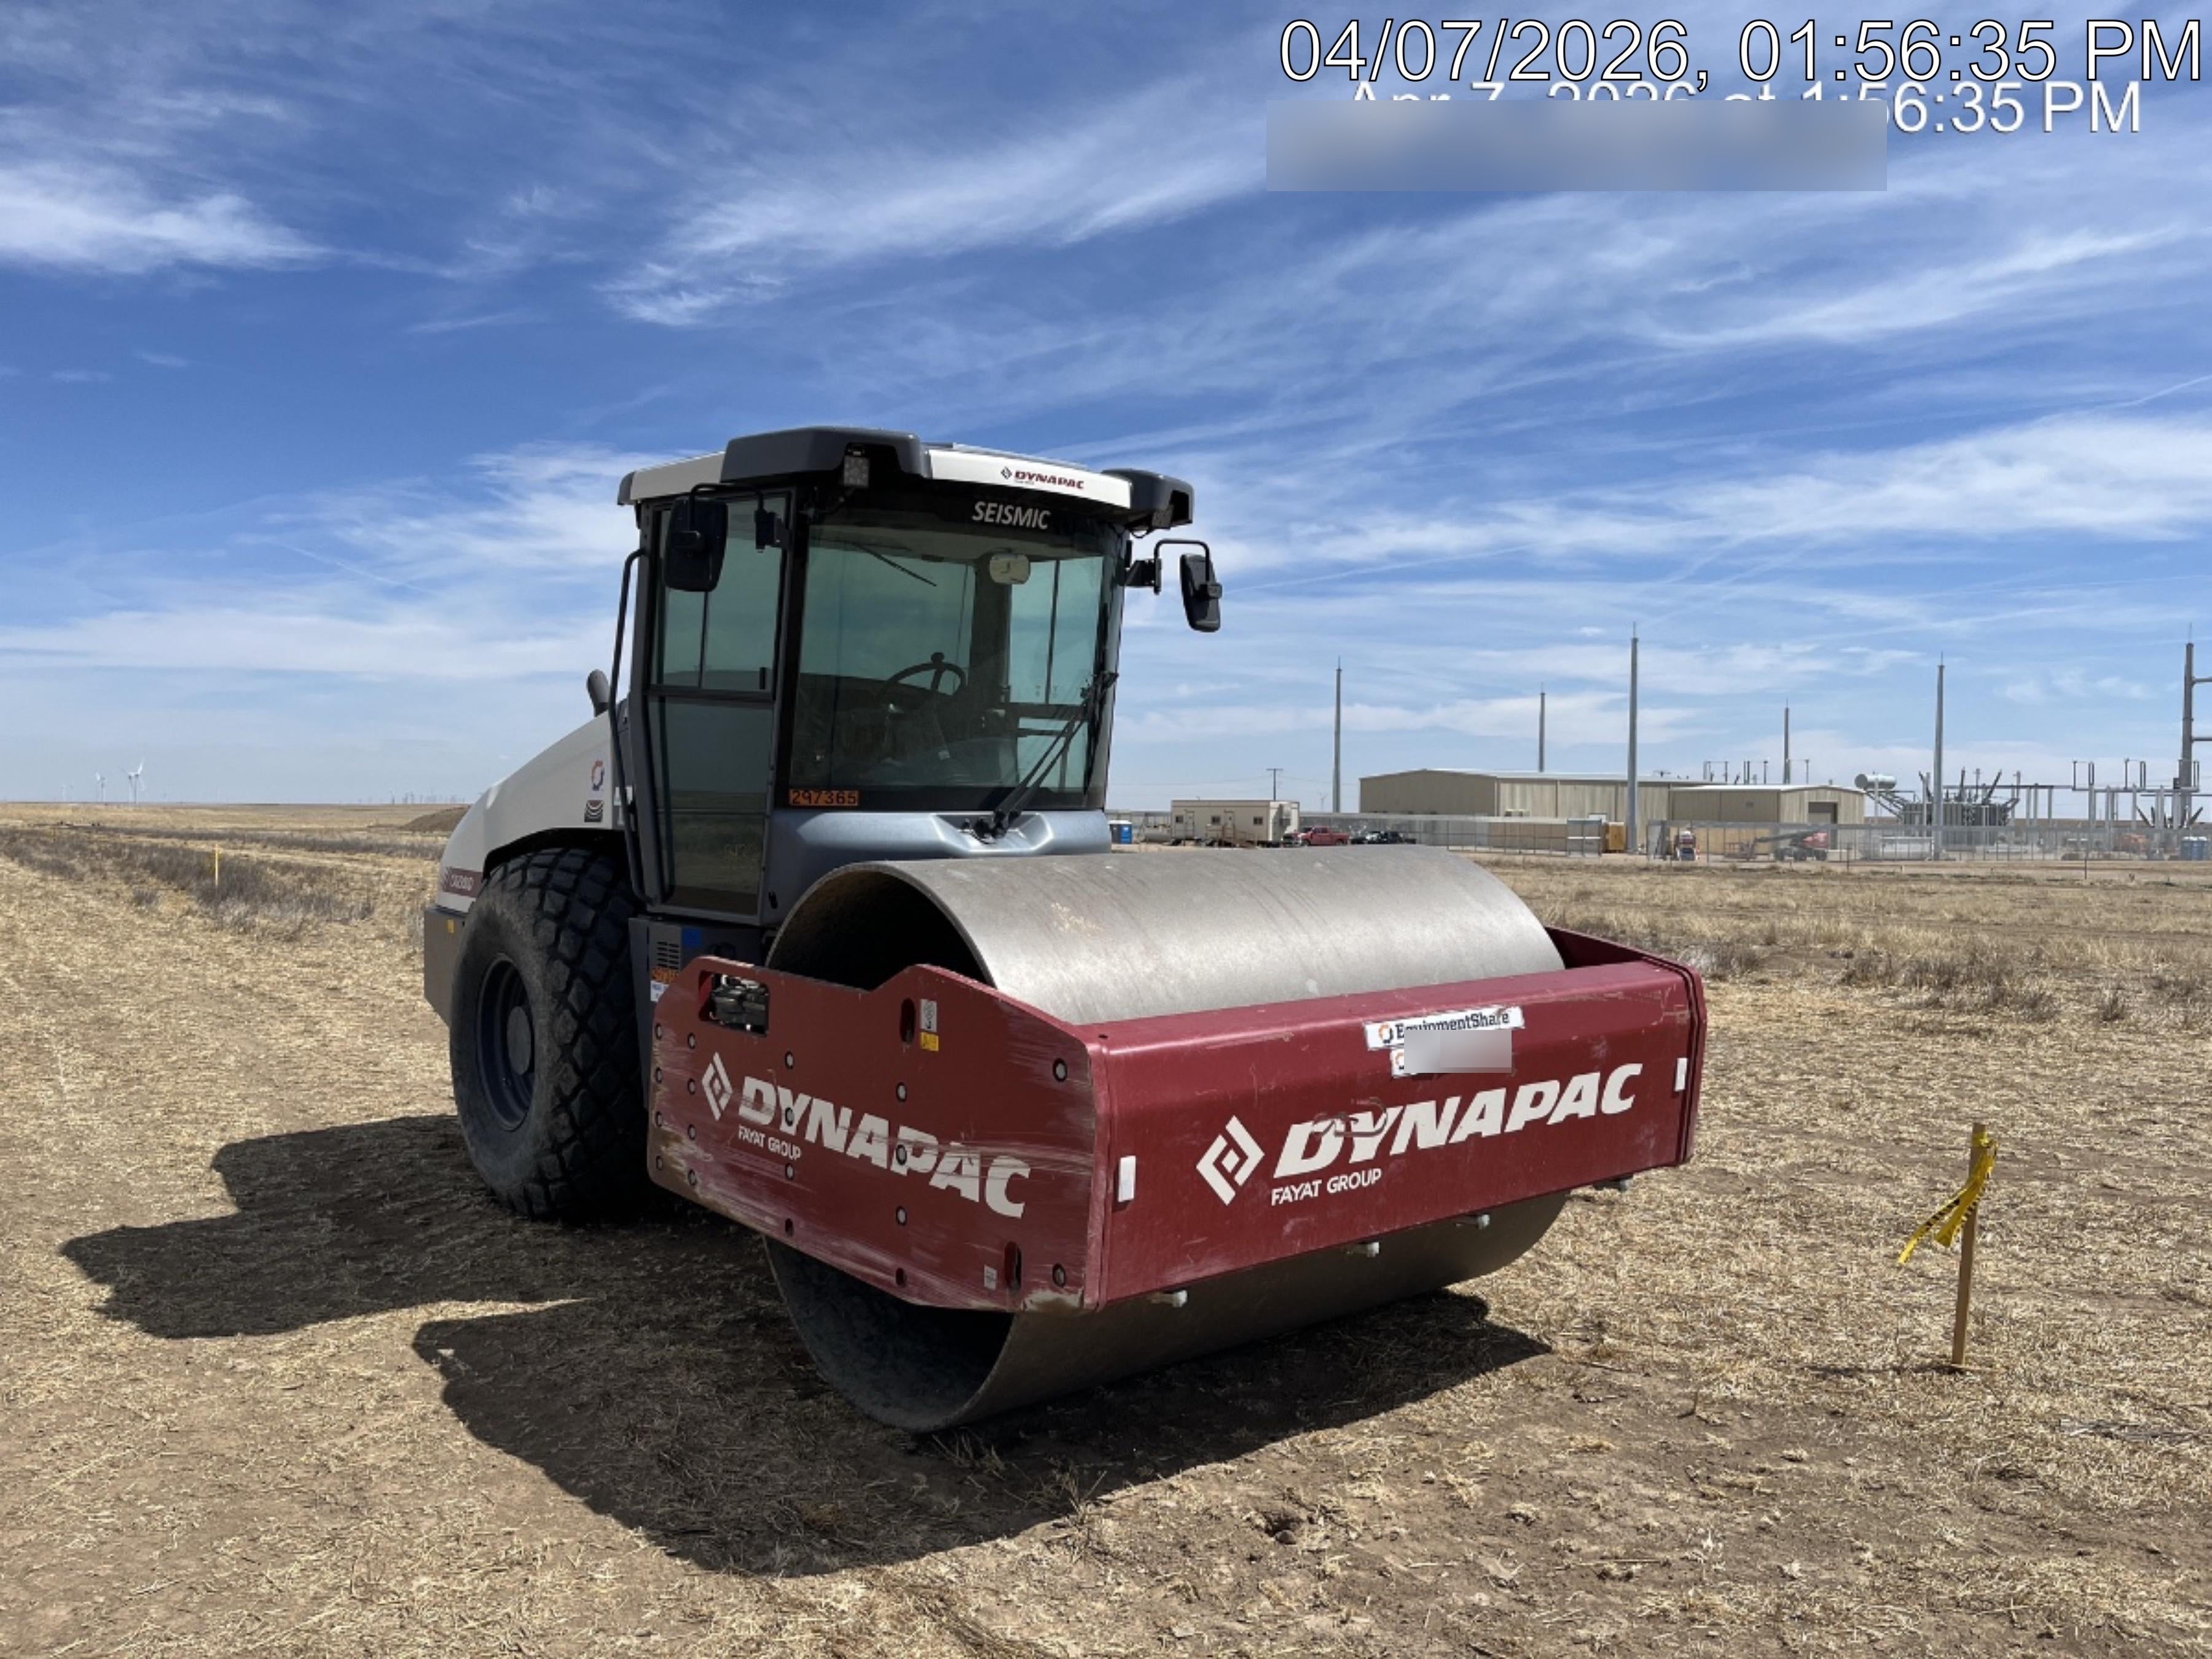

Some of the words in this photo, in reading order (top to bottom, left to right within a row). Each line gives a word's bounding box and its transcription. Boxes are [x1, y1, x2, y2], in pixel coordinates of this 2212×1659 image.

[1015, 471, 1084, 490] DYNAPAC
[972, 501, 1051, 530] SEISMIC
[792, 790, 857, 805] 297365
[1273, 1064, 1643, 1179] DYNAPAC
[739, 1124, 766, 1148] FAYAT
[767, 1136, 802, 1161] GROUP
[739, 1076, 1031, 1219] DYNAPAC
[1271, 1179, 1322, 1206] FAYAT
[1327, 1167, 1382, 1194] GROUP
